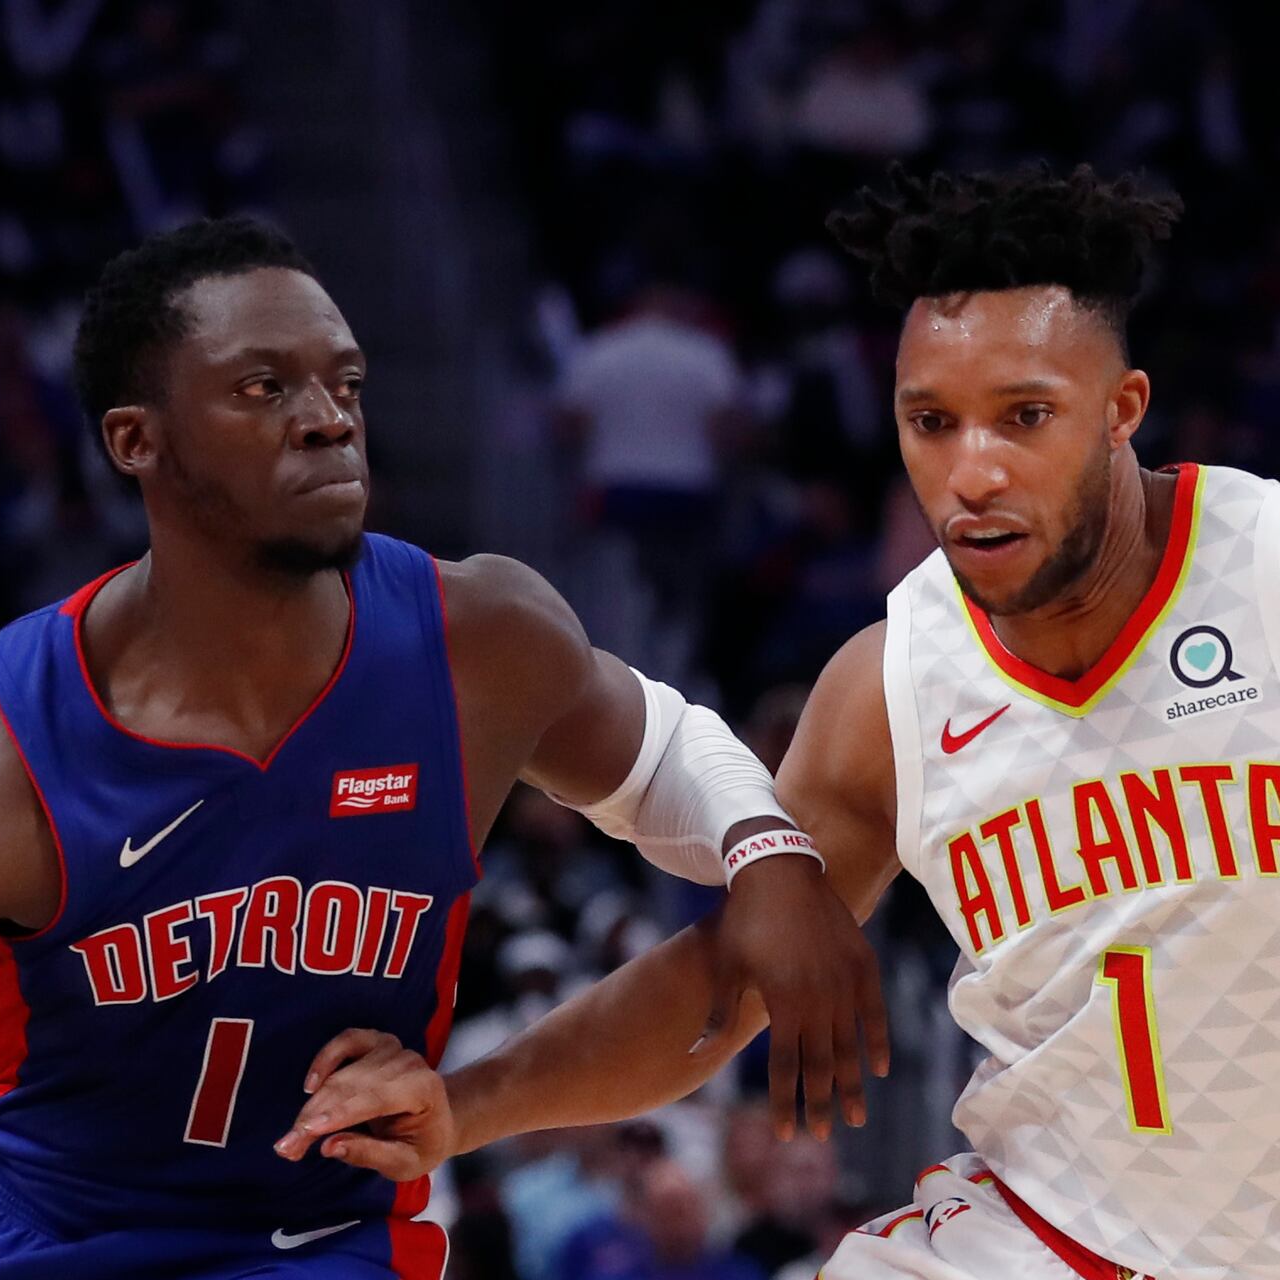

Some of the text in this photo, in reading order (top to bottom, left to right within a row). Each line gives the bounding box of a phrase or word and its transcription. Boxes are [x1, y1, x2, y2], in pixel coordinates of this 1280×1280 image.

[1166, 687, 1258, 720] sharecare
[337, 773, 413, 796] Flagstar
[383, 793, 410, 805] Bank
[727, 836, 777, 869] RYAN
[69, 876, 433, 1006] DETROIT
[1097, 945, 1173, 1136] 1
[183, 1017, 254, 1148] 1
